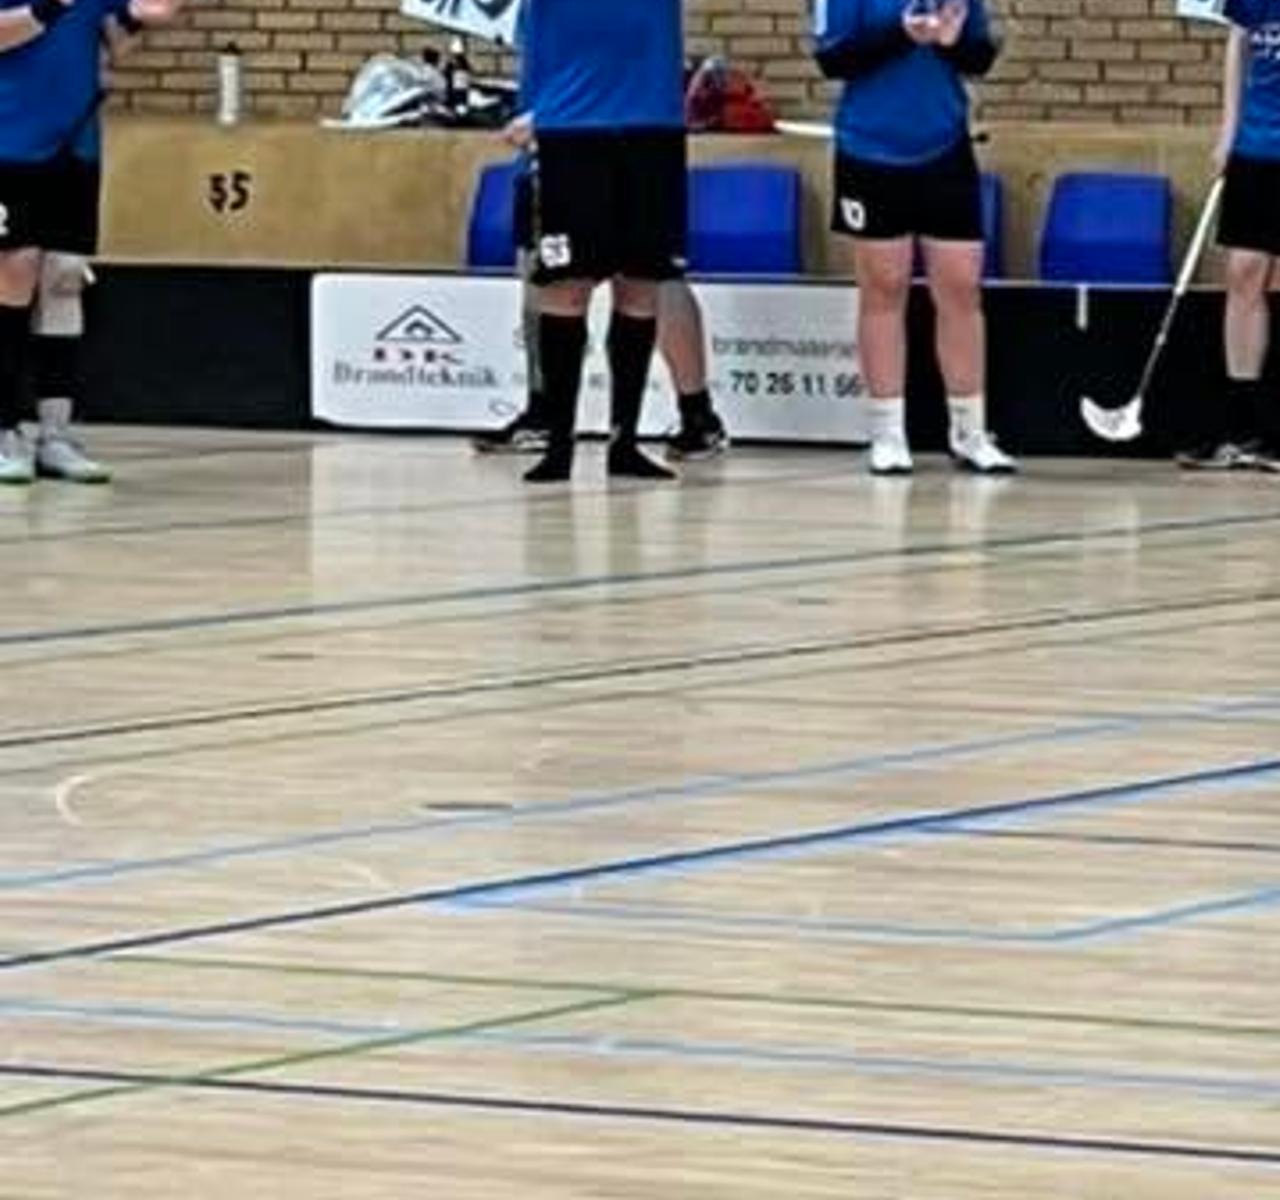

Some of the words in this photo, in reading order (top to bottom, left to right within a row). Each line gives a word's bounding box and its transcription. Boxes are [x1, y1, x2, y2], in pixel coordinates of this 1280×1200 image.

[730, 370, 760, 394] 70
[766, 372, 795, 394] 26
[803, 374, 826, 395] 11
